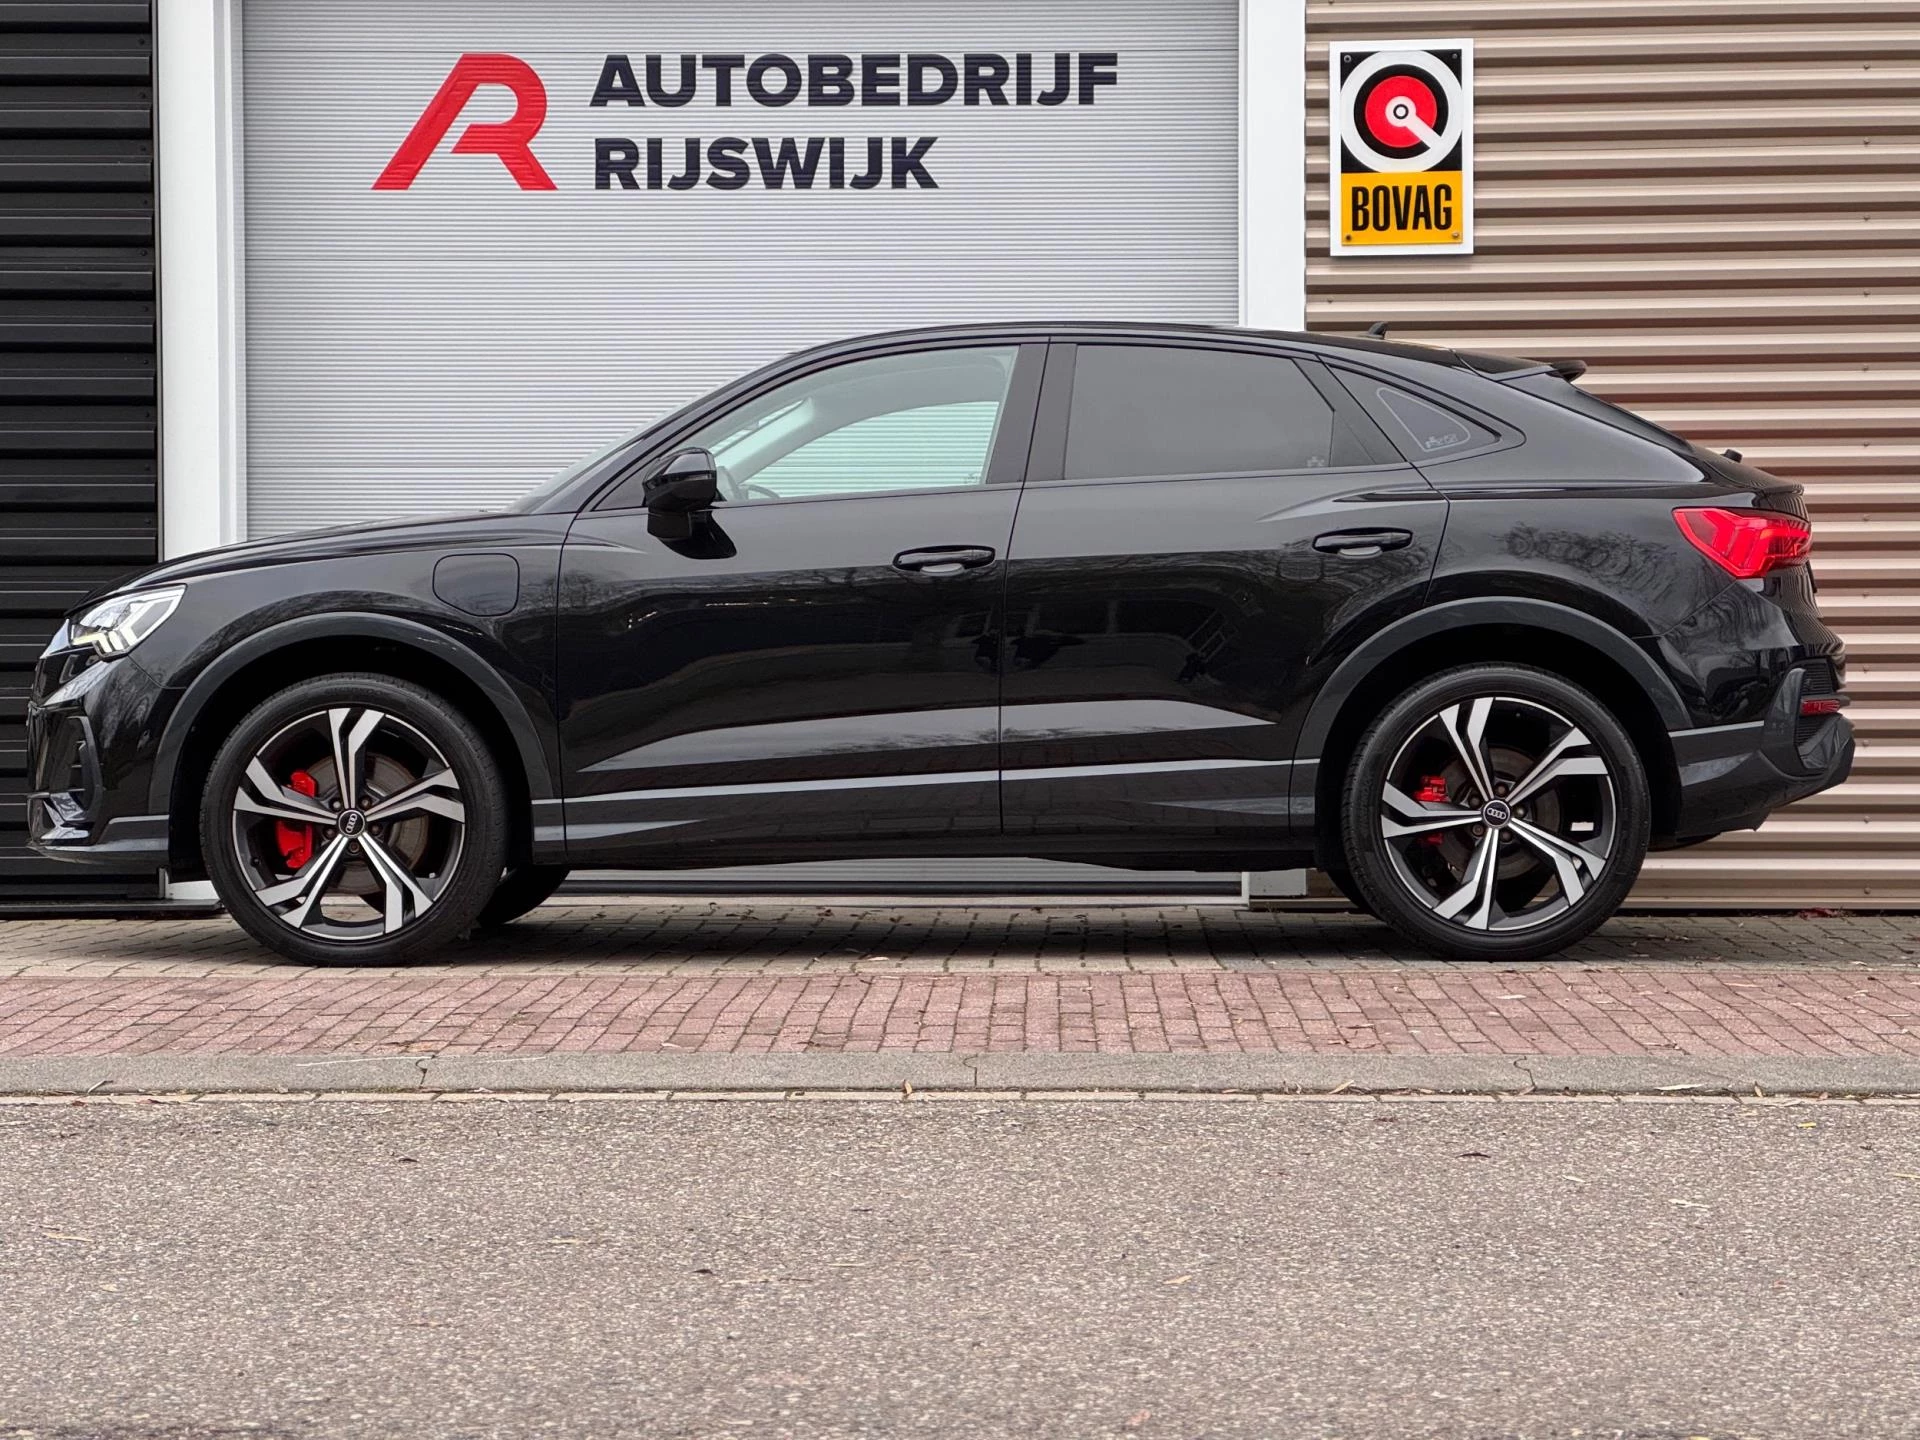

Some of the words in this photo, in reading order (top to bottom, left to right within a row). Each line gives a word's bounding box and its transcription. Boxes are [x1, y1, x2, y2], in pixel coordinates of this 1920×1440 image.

[590, 52, 1118, 108] AUTOBEDRIJF
[594, 136, 939, 191] RIJSWIJK
[1351, 183, 1452, 231] BOVAG
